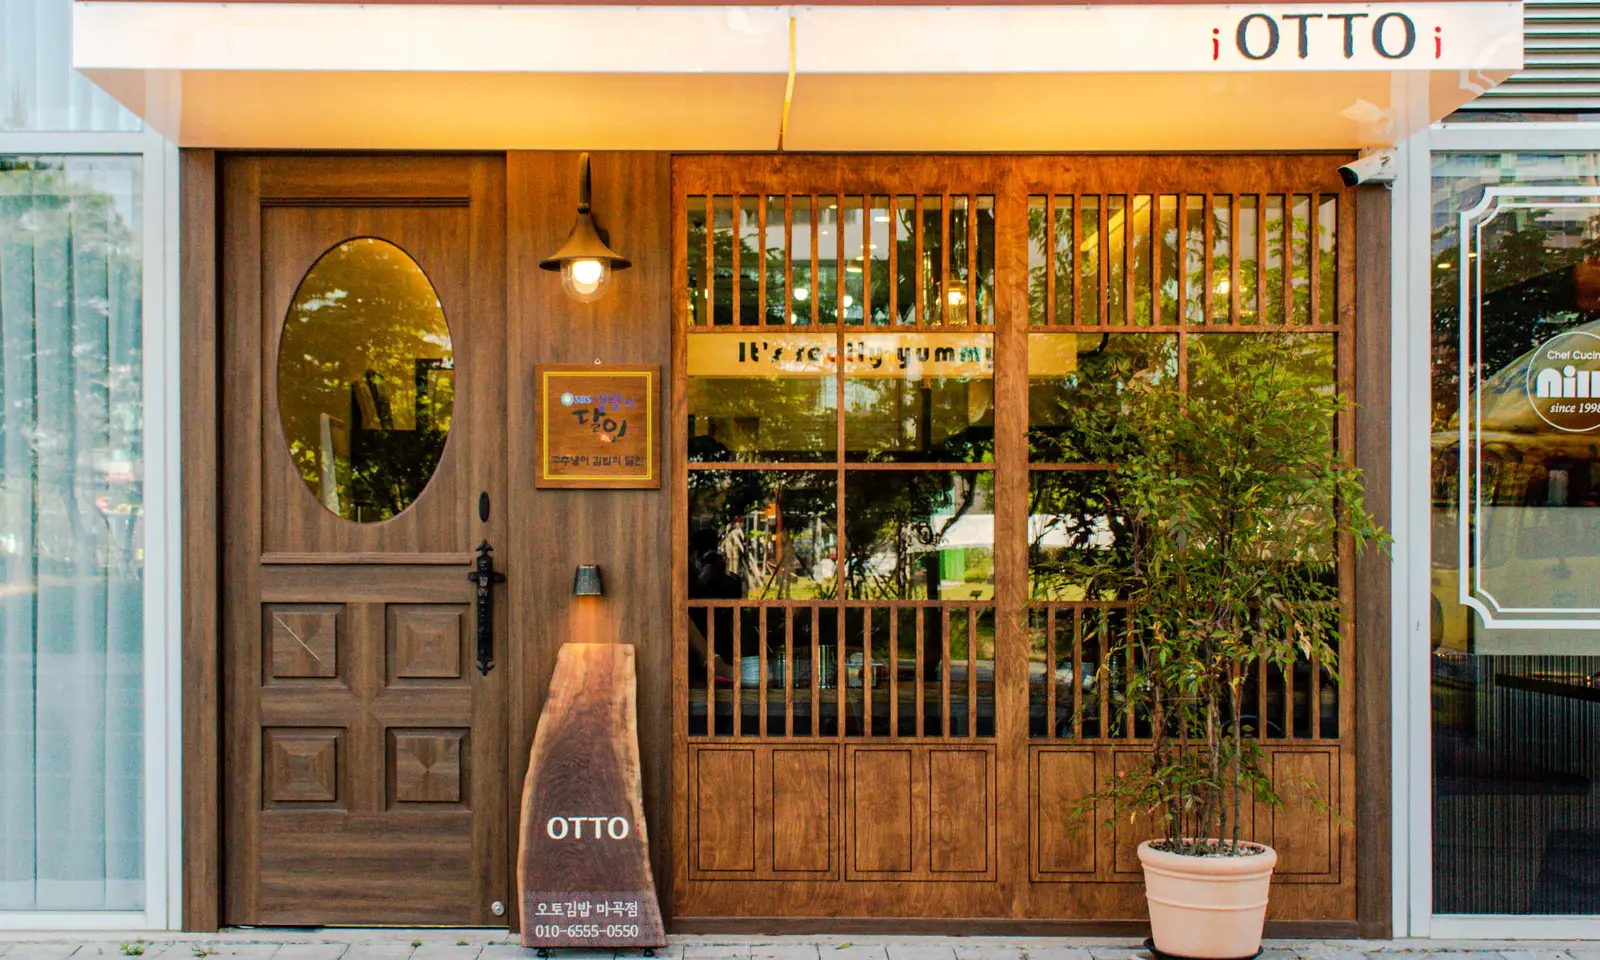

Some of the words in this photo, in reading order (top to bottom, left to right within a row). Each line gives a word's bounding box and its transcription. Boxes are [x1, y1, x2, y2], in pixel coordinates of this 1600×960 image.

[1235, 12, 1416, 60] OTTO
[738, 341, 783, 363] It's
[1547, 350, 1571, 360] Chef
[575, 395, 591, 405] SBS
[1550, 402, 1576, 413] since
[572, 408, 627, 443] 달인
[546, 816, 630, 840] OTTO
[535, 901, 592, 918] 오토김밥
[596, 901, 639, 918] 마곡점
[535, 924, 639, 938] 010-6555-0550
